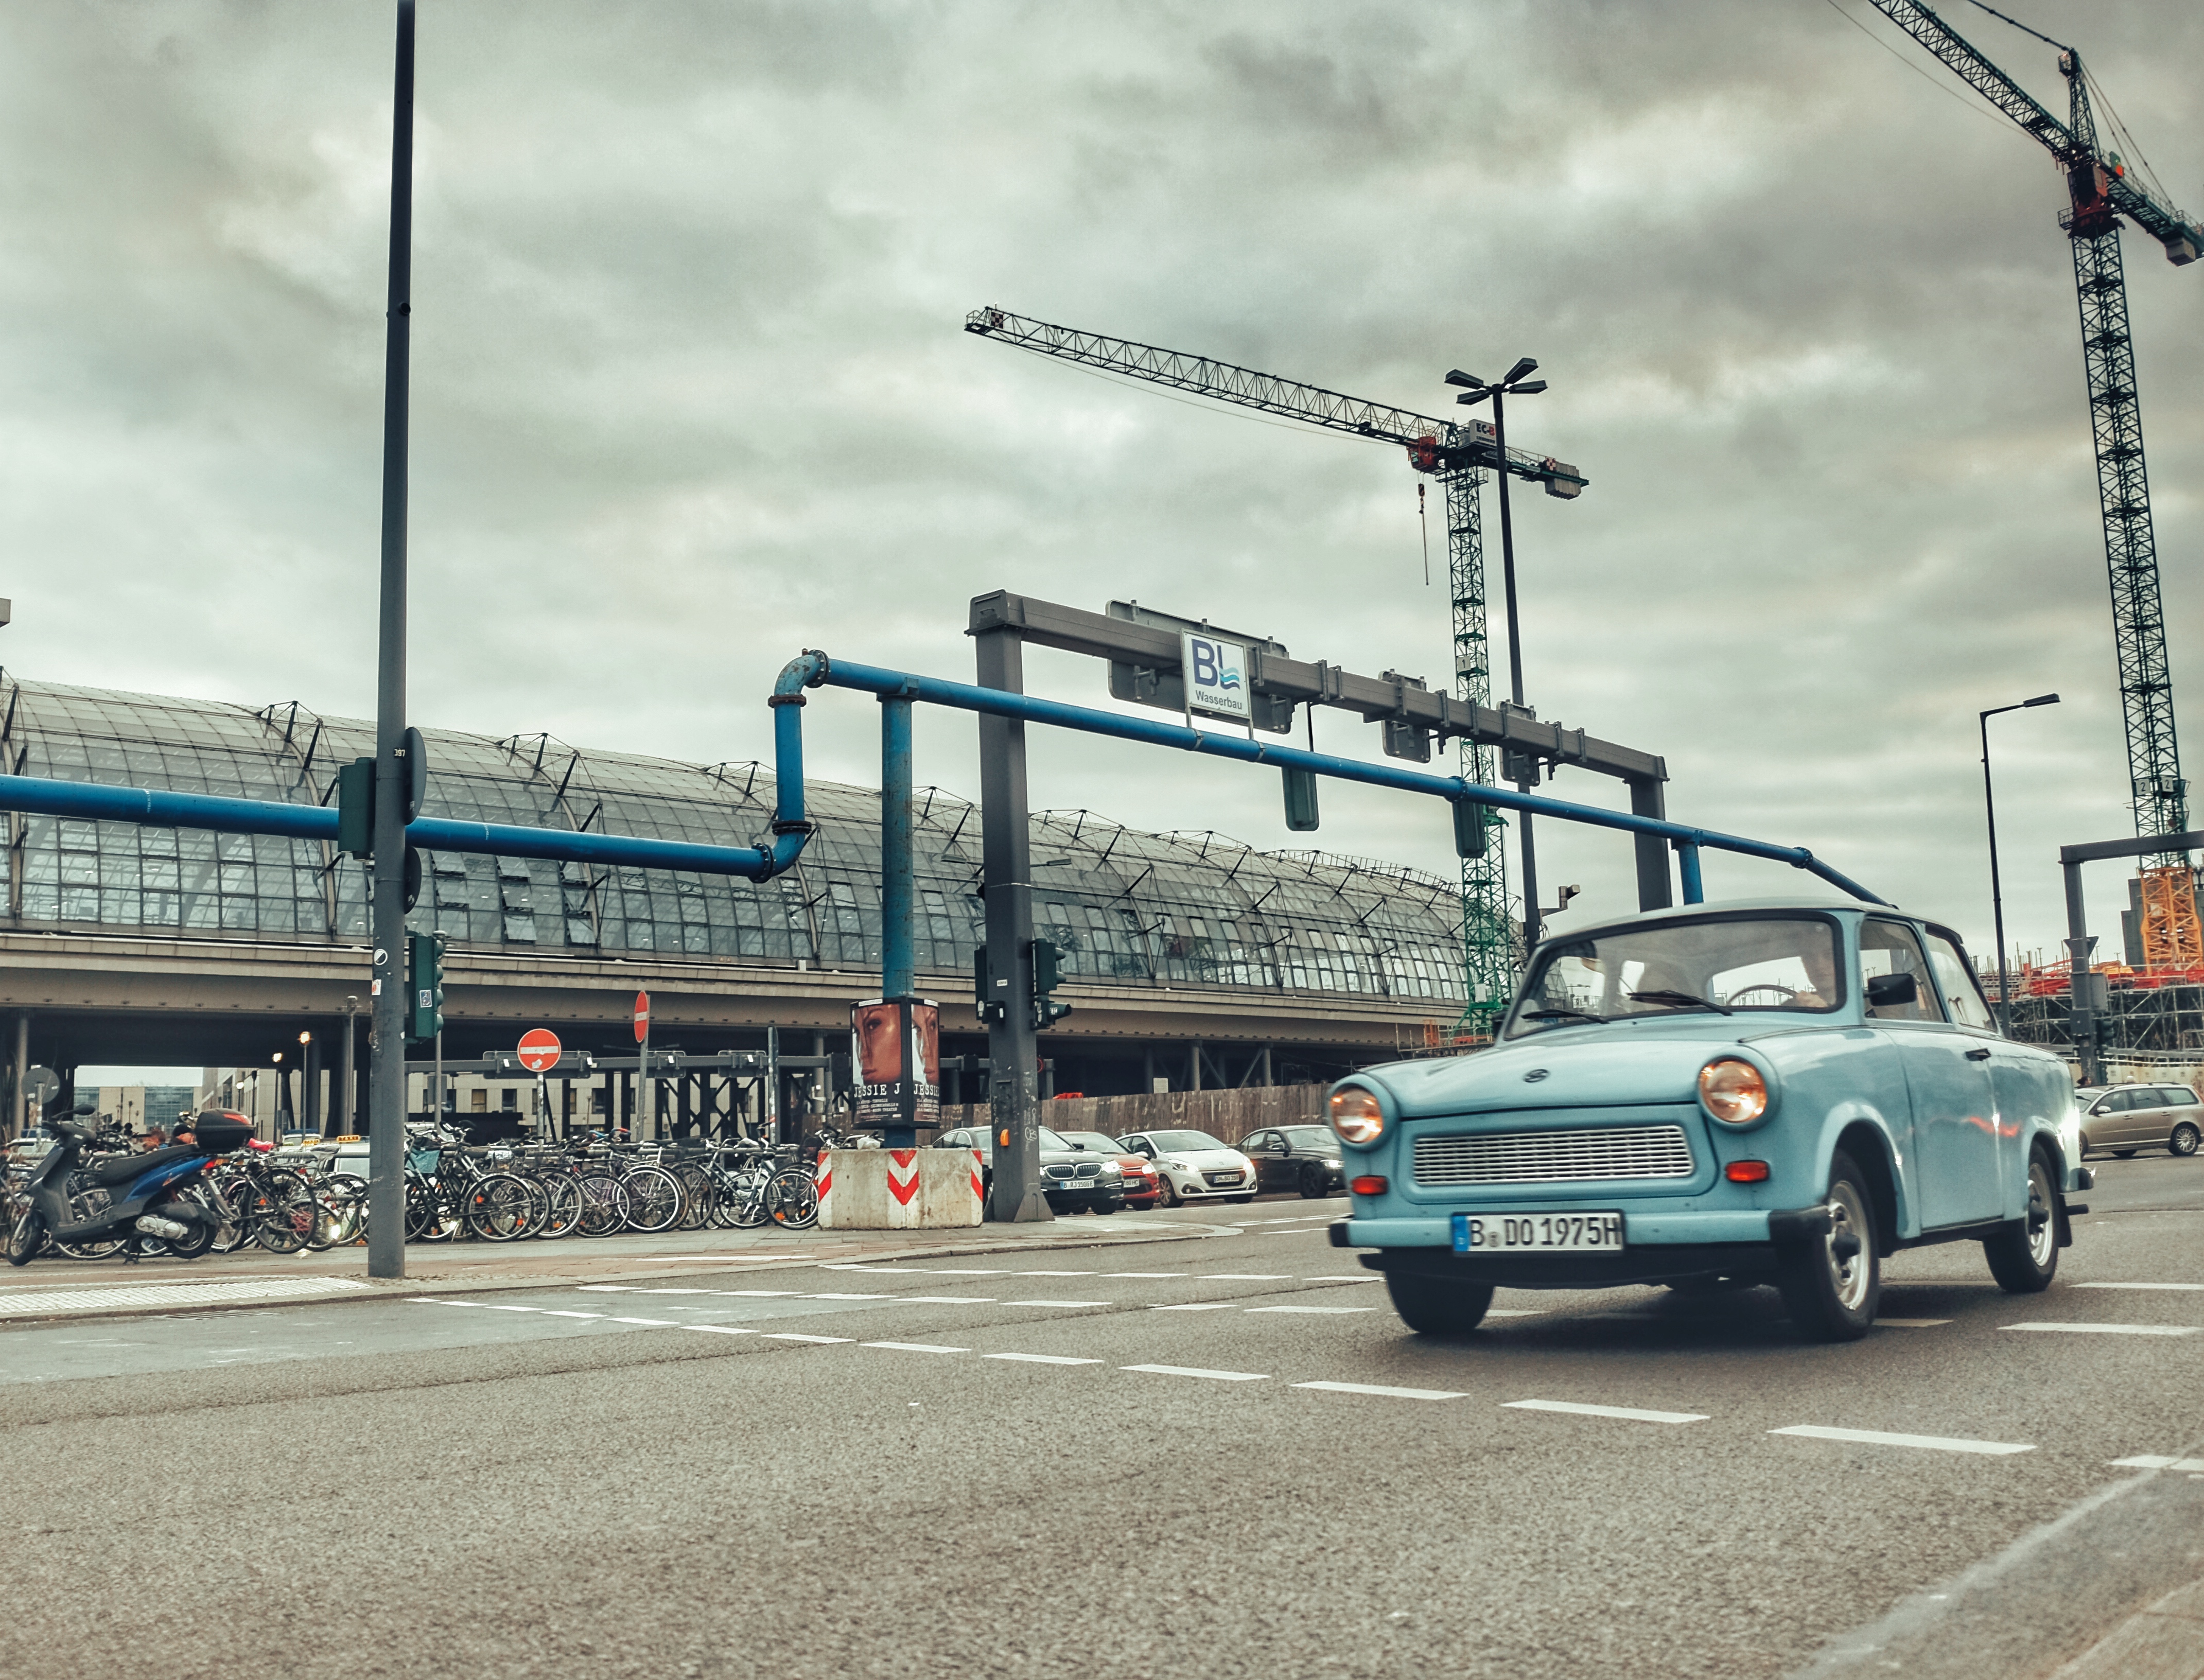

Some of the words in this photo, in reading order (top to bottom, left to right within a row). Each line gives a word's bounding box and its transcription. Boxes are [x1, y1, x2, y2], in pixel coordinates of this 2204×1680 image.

[1476, 423, 1495, 436] EC-B
[1462, 659, 1465, 669] 1
[1195, 690, 1243, 710] Wasserbau
[394, 748, 406, 757] 397
[2140, 782, 2146, 792] 2
[2165, 779, 2171, 790] 2
[854, 1084, 887, 1097] JESSIE
[894, 1083, 901, 1094] J
[1471, 1219, 1484, 1246] B
